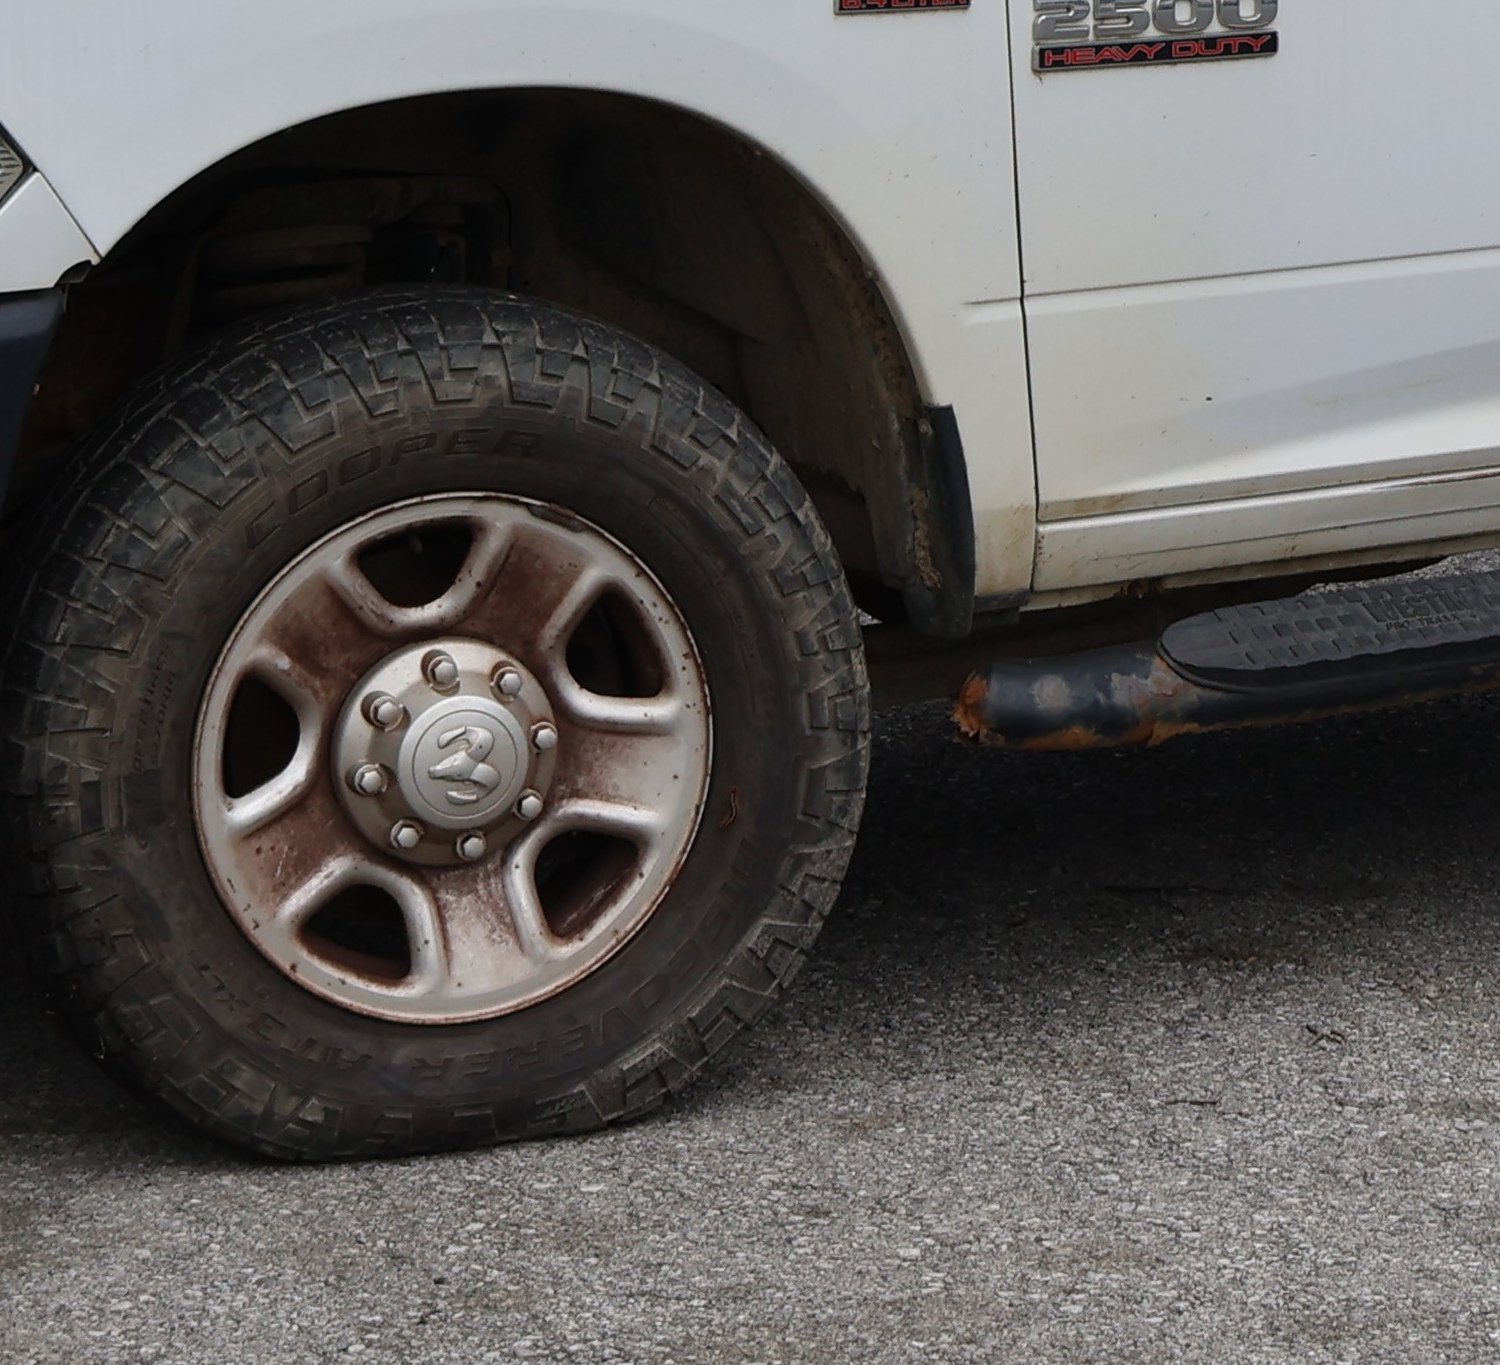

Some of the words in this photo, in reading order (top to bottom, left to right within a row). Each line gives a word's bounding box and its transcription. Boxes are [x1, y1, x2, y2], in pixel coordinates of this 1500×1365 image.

[1044, 42, 1166, 67] HEAVY
[1172, 35, 1271, 57] DUTY
[246, 426, 544, 551] COOPER
[1362, 590, 1473, 624] WESTIN
